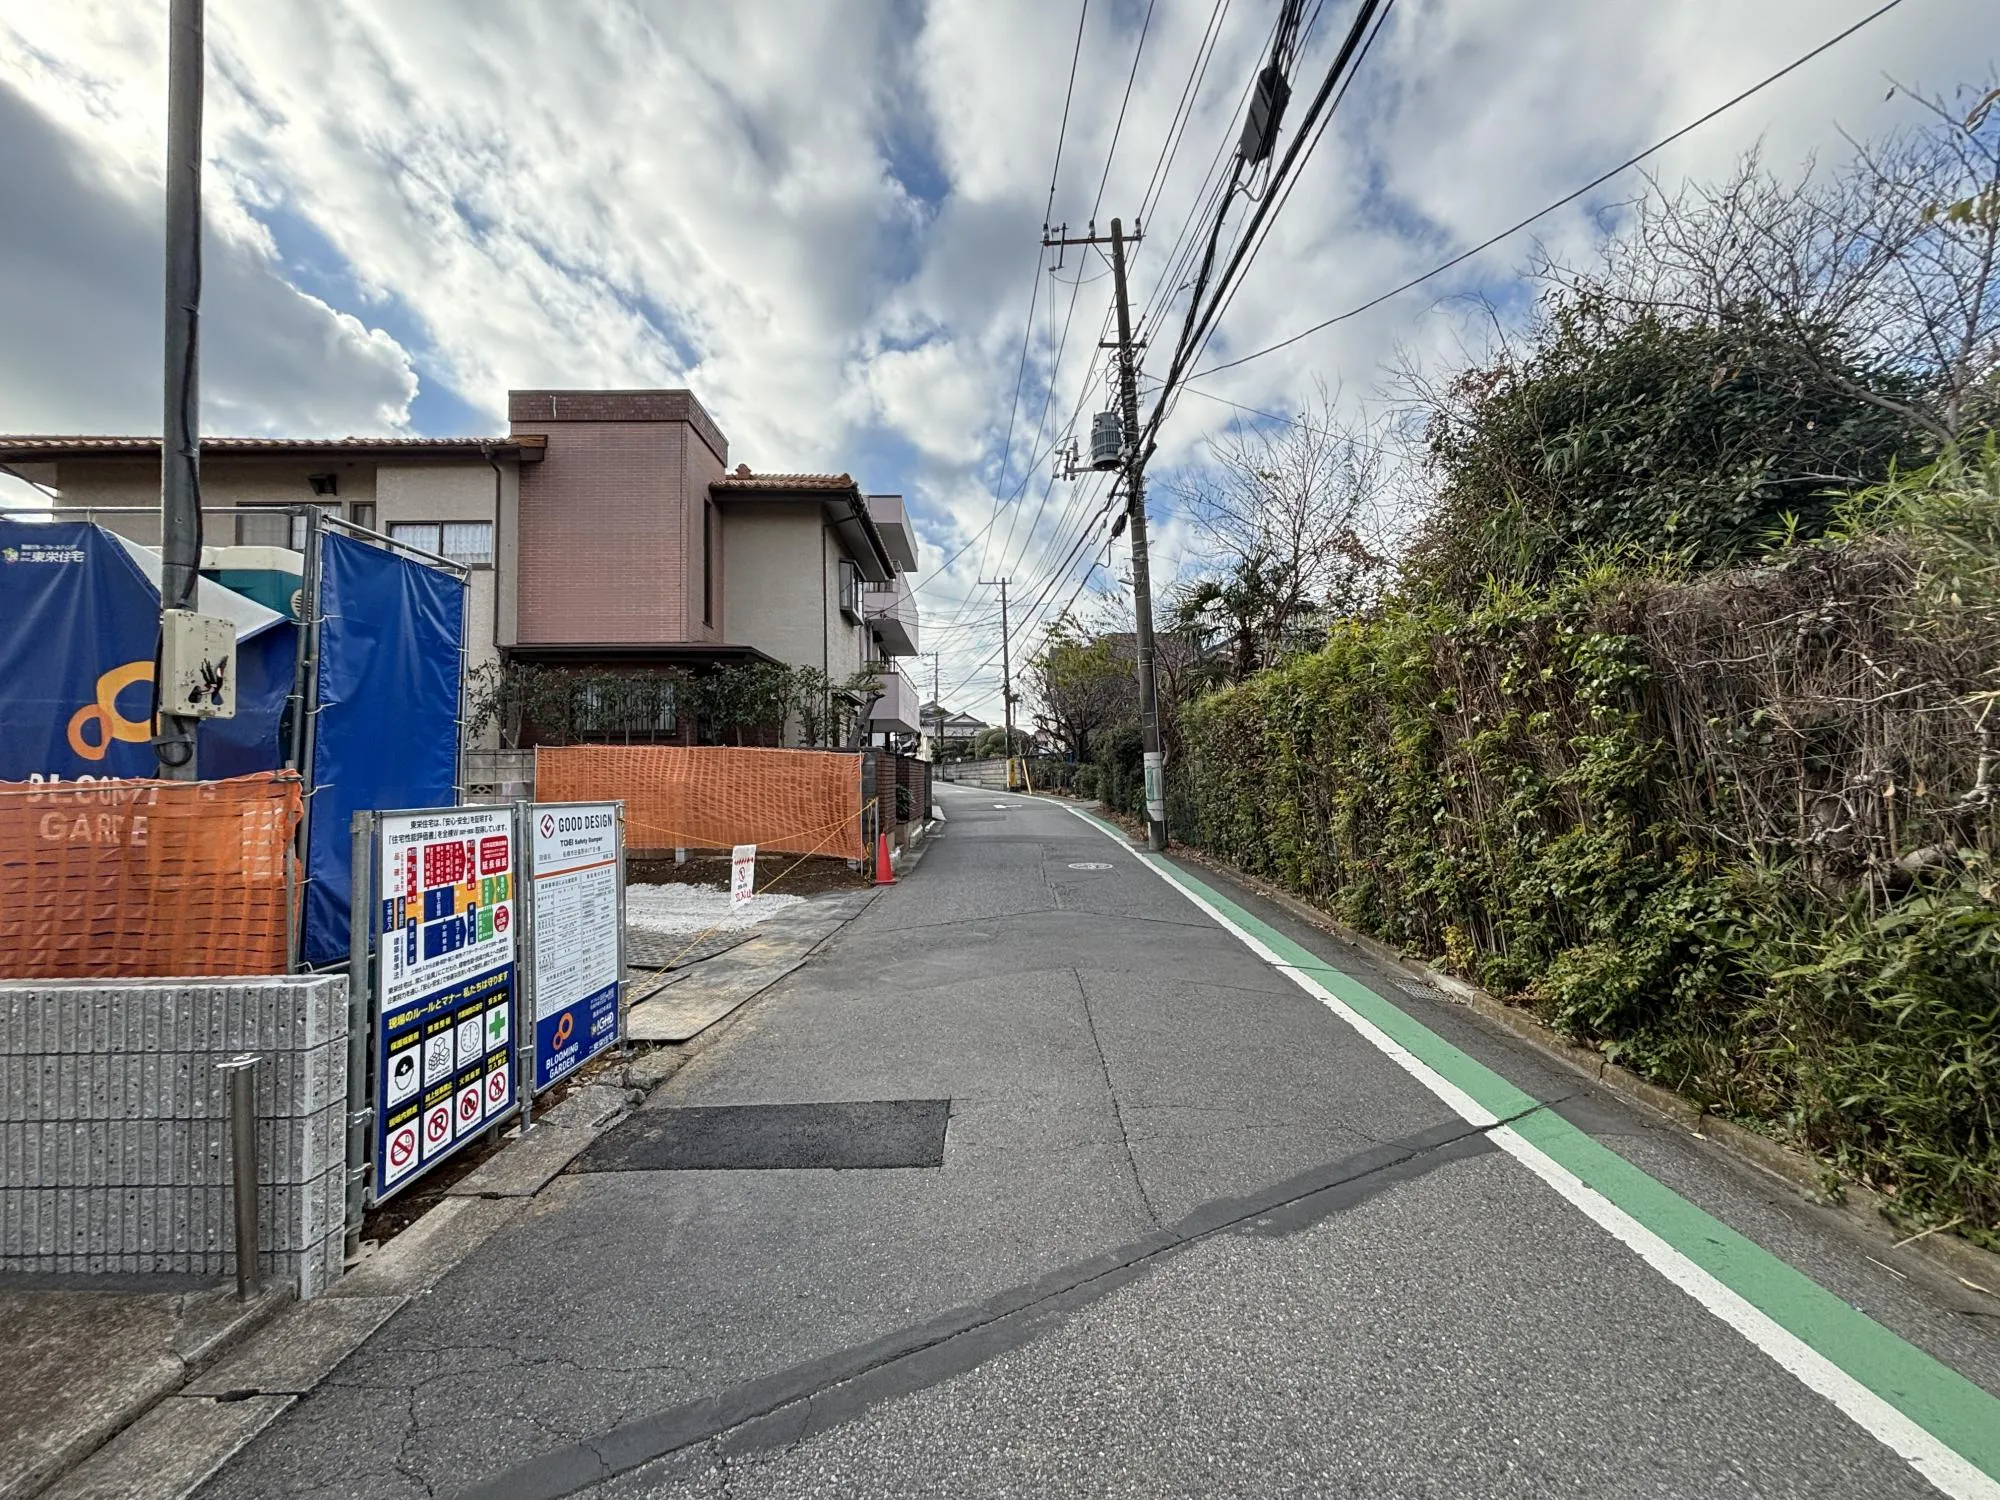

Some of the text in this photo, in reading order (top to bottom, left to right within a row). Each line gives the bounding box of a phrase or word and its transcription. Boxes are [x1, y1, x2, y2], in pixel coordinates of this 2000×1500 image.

[32, 551, 85, 562] 東栄住宅
[40, 811, 148, 846] GARDE
[558, 813, 613, 833] GOOD DESIGN
[388, 971, 509, 1030] 現場のルールとマナー 私たちは守ります
[546, 1042, 579, 1070] BLOOMING
[550, 1055, 575, 1079] GARDEN
